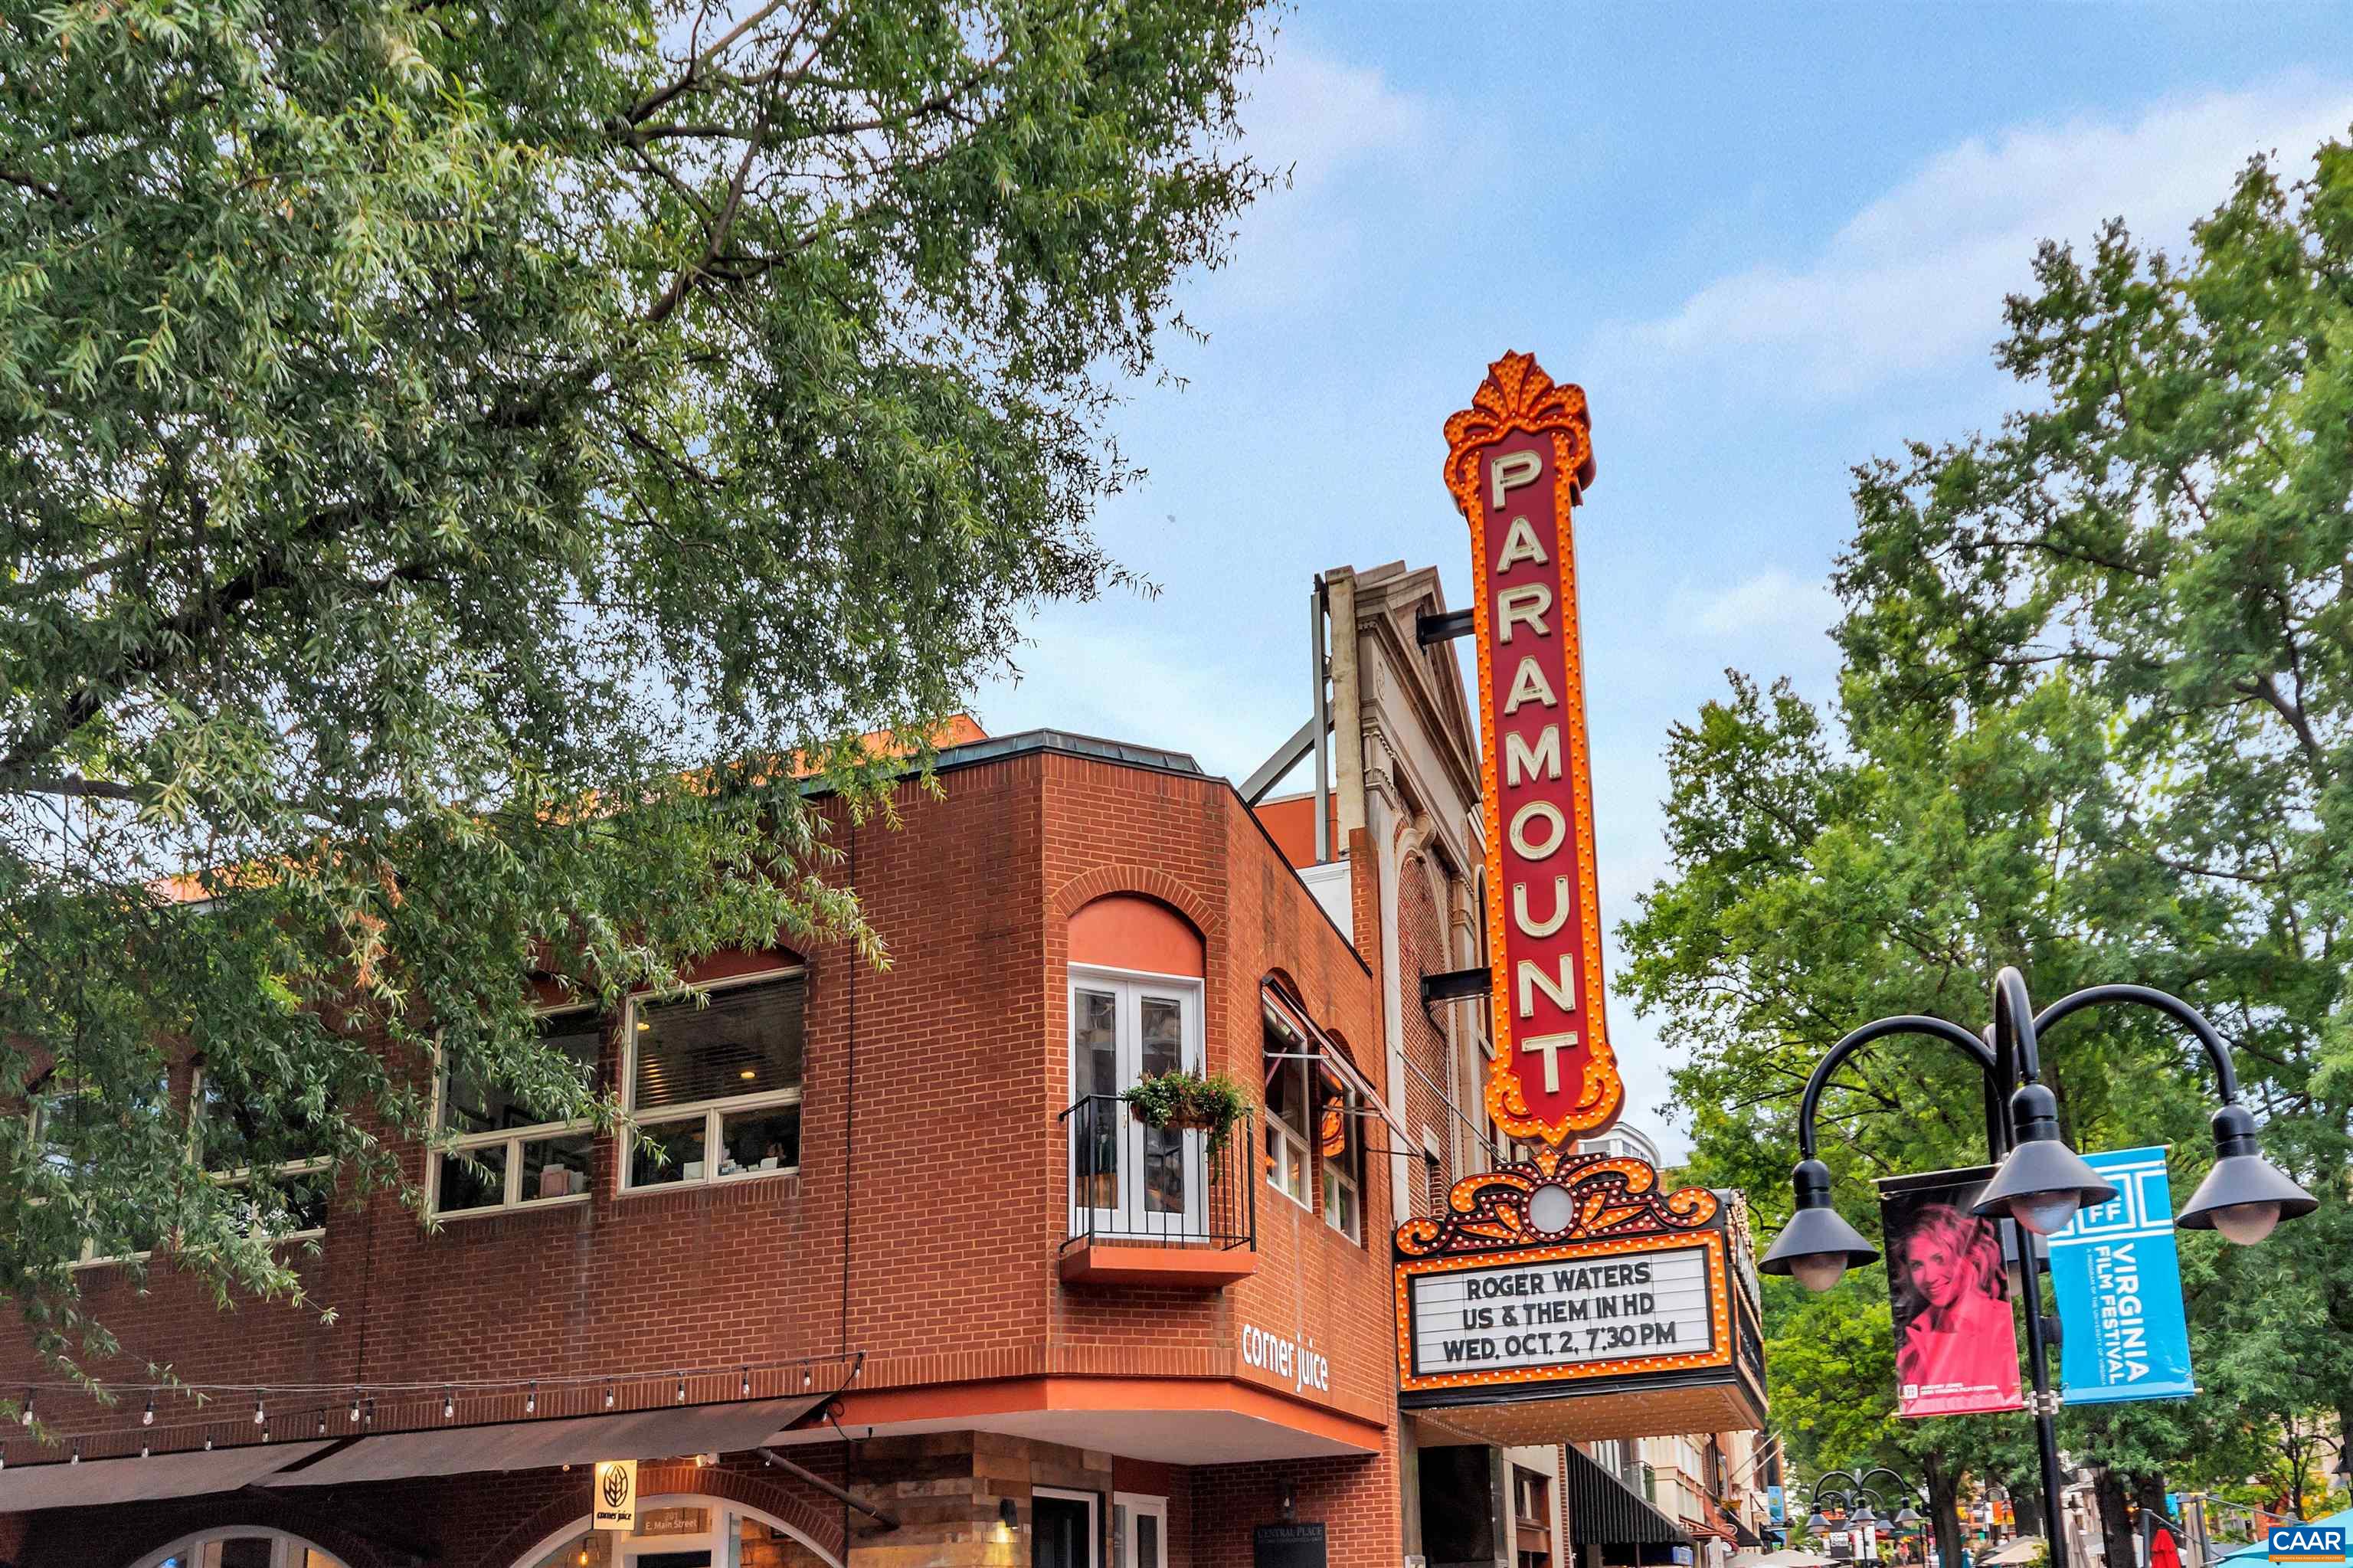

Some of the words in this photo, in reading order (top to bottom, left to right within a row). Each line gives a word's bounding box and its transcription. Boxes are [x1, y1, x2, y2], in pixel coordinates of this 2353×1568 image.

[1491, 449, 1579, 1094] PARAMOUNT
[1466, 1272, 1545, 1301] ROGER
[1553, 1261, 1651, 1291] WATERS
[2094, 1245, 2114, 1289] FILM
[1463, 1307, 1494, 1330] US
[1502, 1304, 1518, 1327] &
[1523, 1298, 1588, 1324] THEM
[1595, 1295, 1621, 1319] IN
[1623, 1291, 1655, 1316] HD
[2112, 1242, 2150, 1383] VIRGINIA
[1242, 1323, 1295, 1378] corner
[1296, 1332, 1329, 1393] juice
[1443, 1337, 1500, 1363] WED.
[1504, 1332, 1554, 1357] OCT.
[1559, 1331, 1579, 1355] 2,
[1586, 1325, 1636, 1352] 7:30
[1641, 1321, 1677, 1346] PM
[2100, 1295, 2125, 1385] FESTIVAL
[654, 1520, 673, 1530] Main
[673, 1518, 697, 1529] Street
